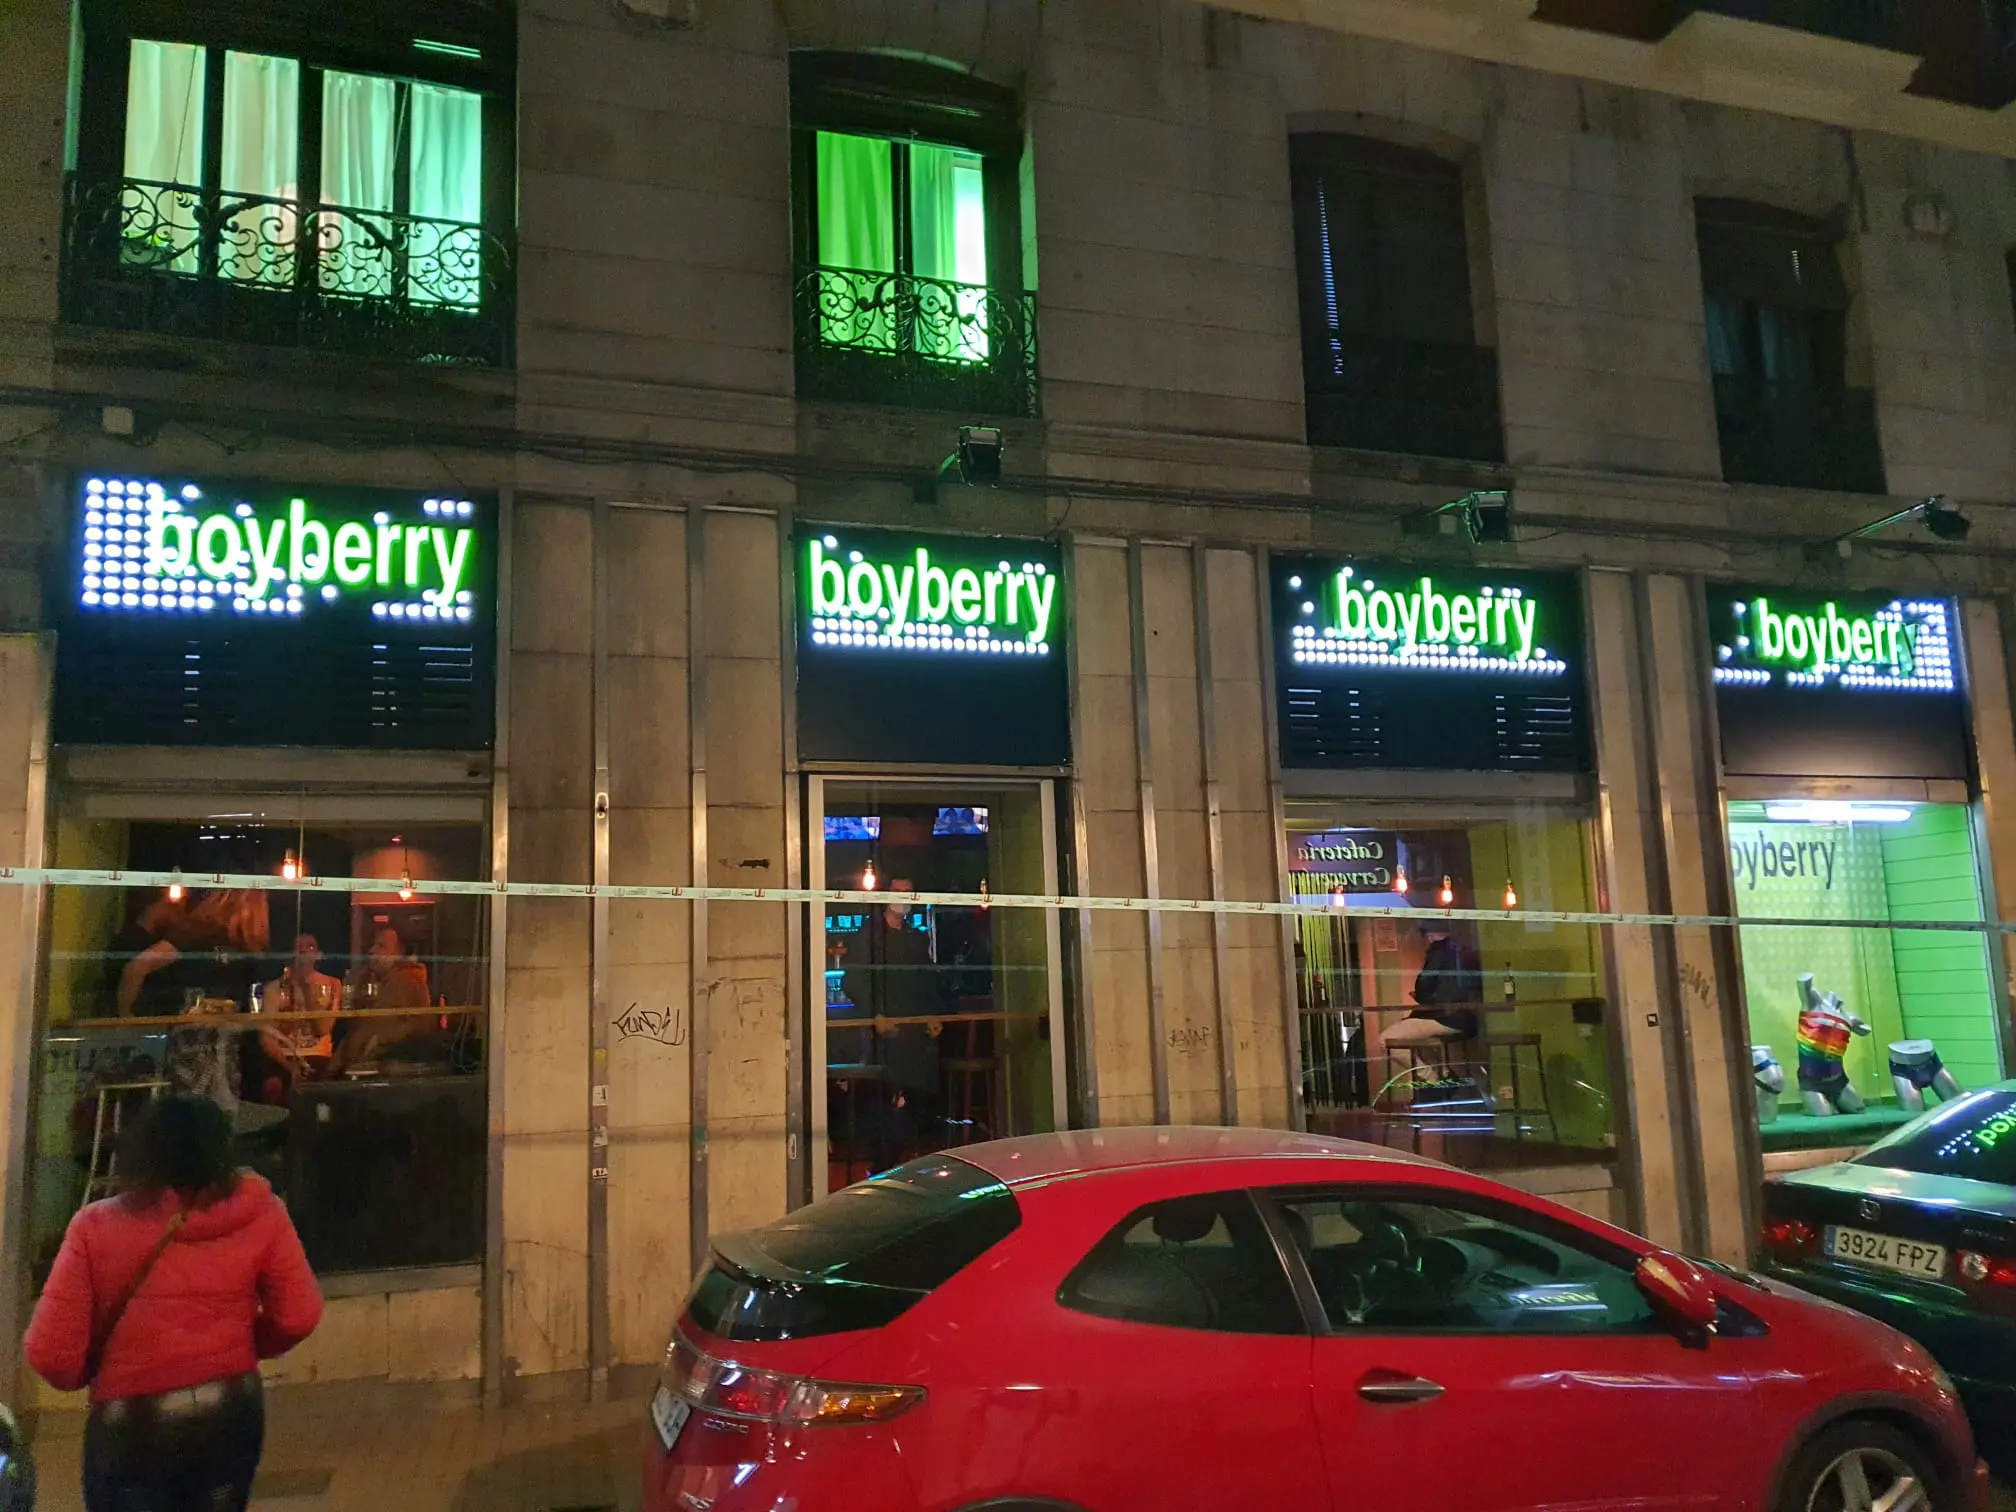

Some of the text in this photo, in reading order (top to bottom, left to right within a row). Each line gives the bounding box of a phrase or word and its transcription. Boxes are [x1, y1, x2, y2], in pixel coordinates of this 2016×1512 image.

[150, 487, 473, 607] boyberry
[809, 539, 1056, 643] boyberry
[1333, 571, 1537, 662] boyberry
[1754, 597, 1920, 678] boyberry
[1838, 1232, 1939, 1272] 3924 FPZ
